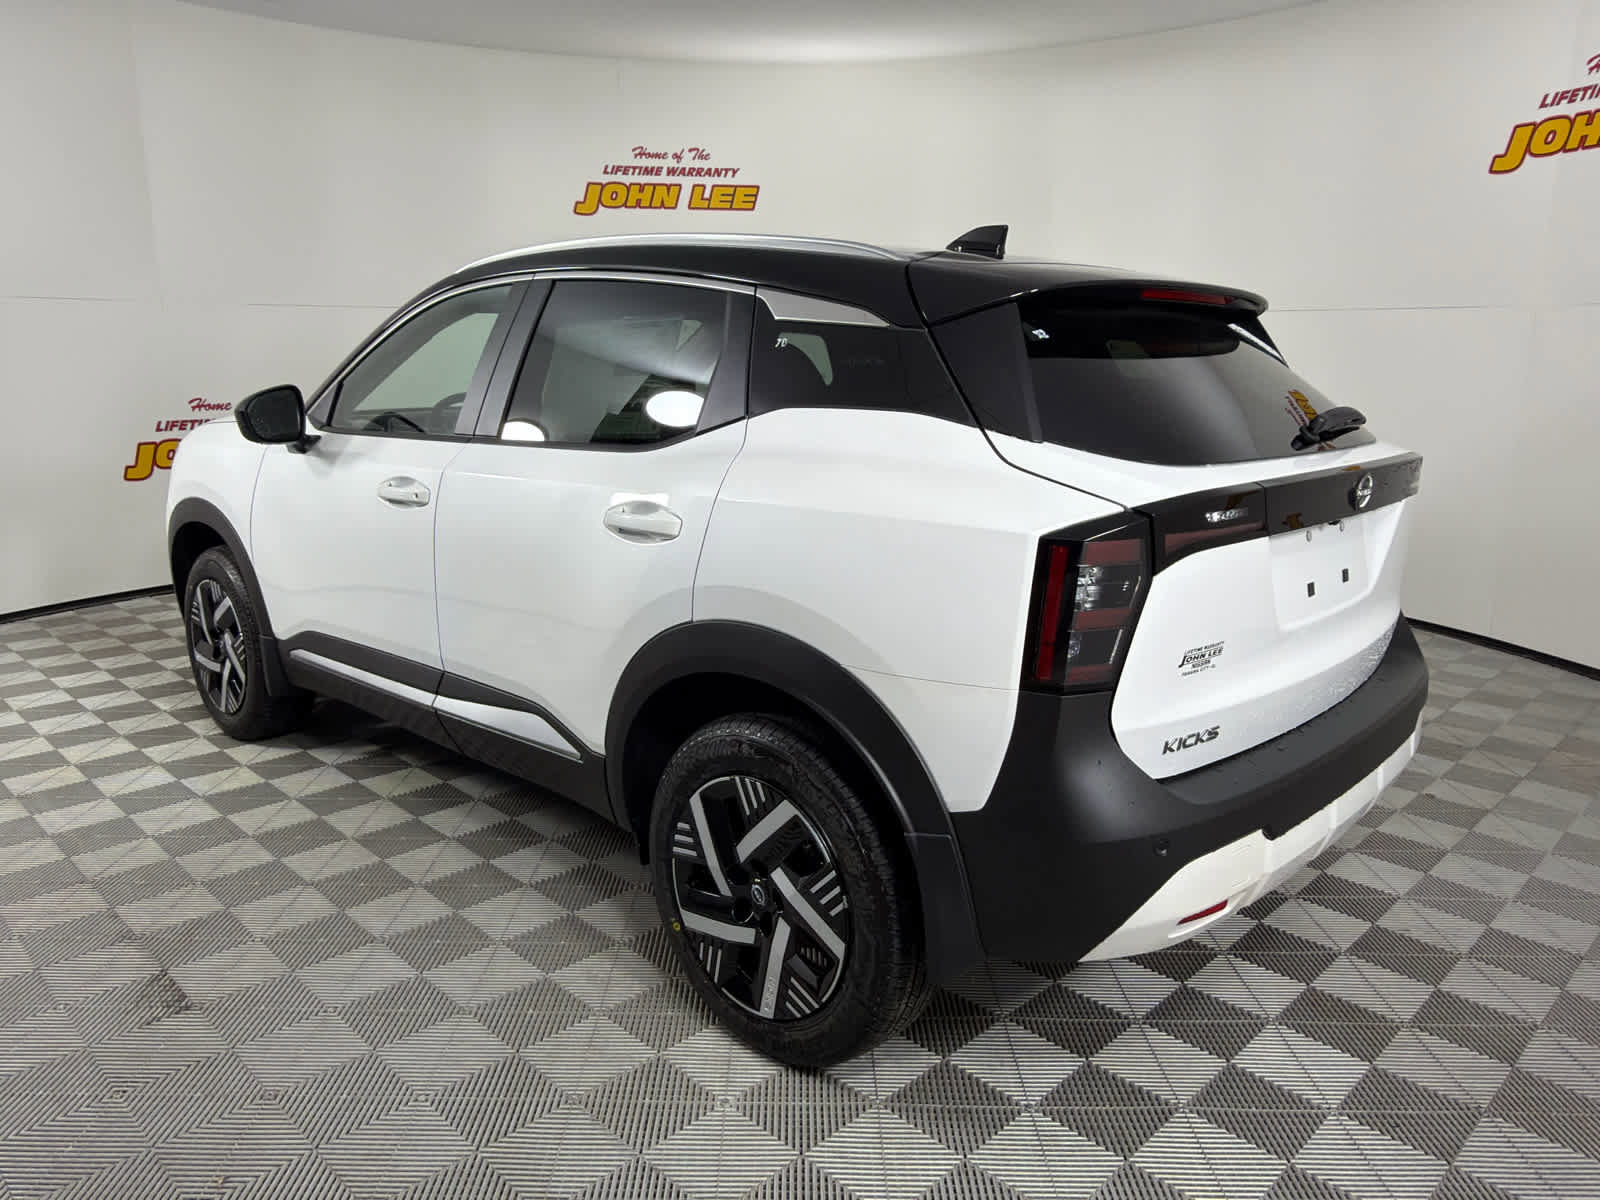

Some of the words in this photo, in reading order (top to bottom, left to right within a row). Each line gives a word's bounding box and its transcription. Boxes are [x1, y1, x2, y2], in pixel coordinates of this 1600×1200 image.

[1539, 83, 1600, 109] LIFETI
[631, 146, 669, 160] Home
[671, 149, 685, 164] of
[688, 147, 711, 161] The
[602, 165, 664, 177] LIFETIME
[666, 167, 740, 178] WARRANTY
[573, 181, 682, 216] JOHN
[688, 184, 760, 211] LEE
[187, 397, 232, 412] Home
[155, 419, 211, 432] LIFETI
[124, 438, 182, 481] JO
[1178, 653, 1206, 668] JOHN
[1207, 646, 1224, 657] LEE
[1162, 725, 1220, 755] KICKS
